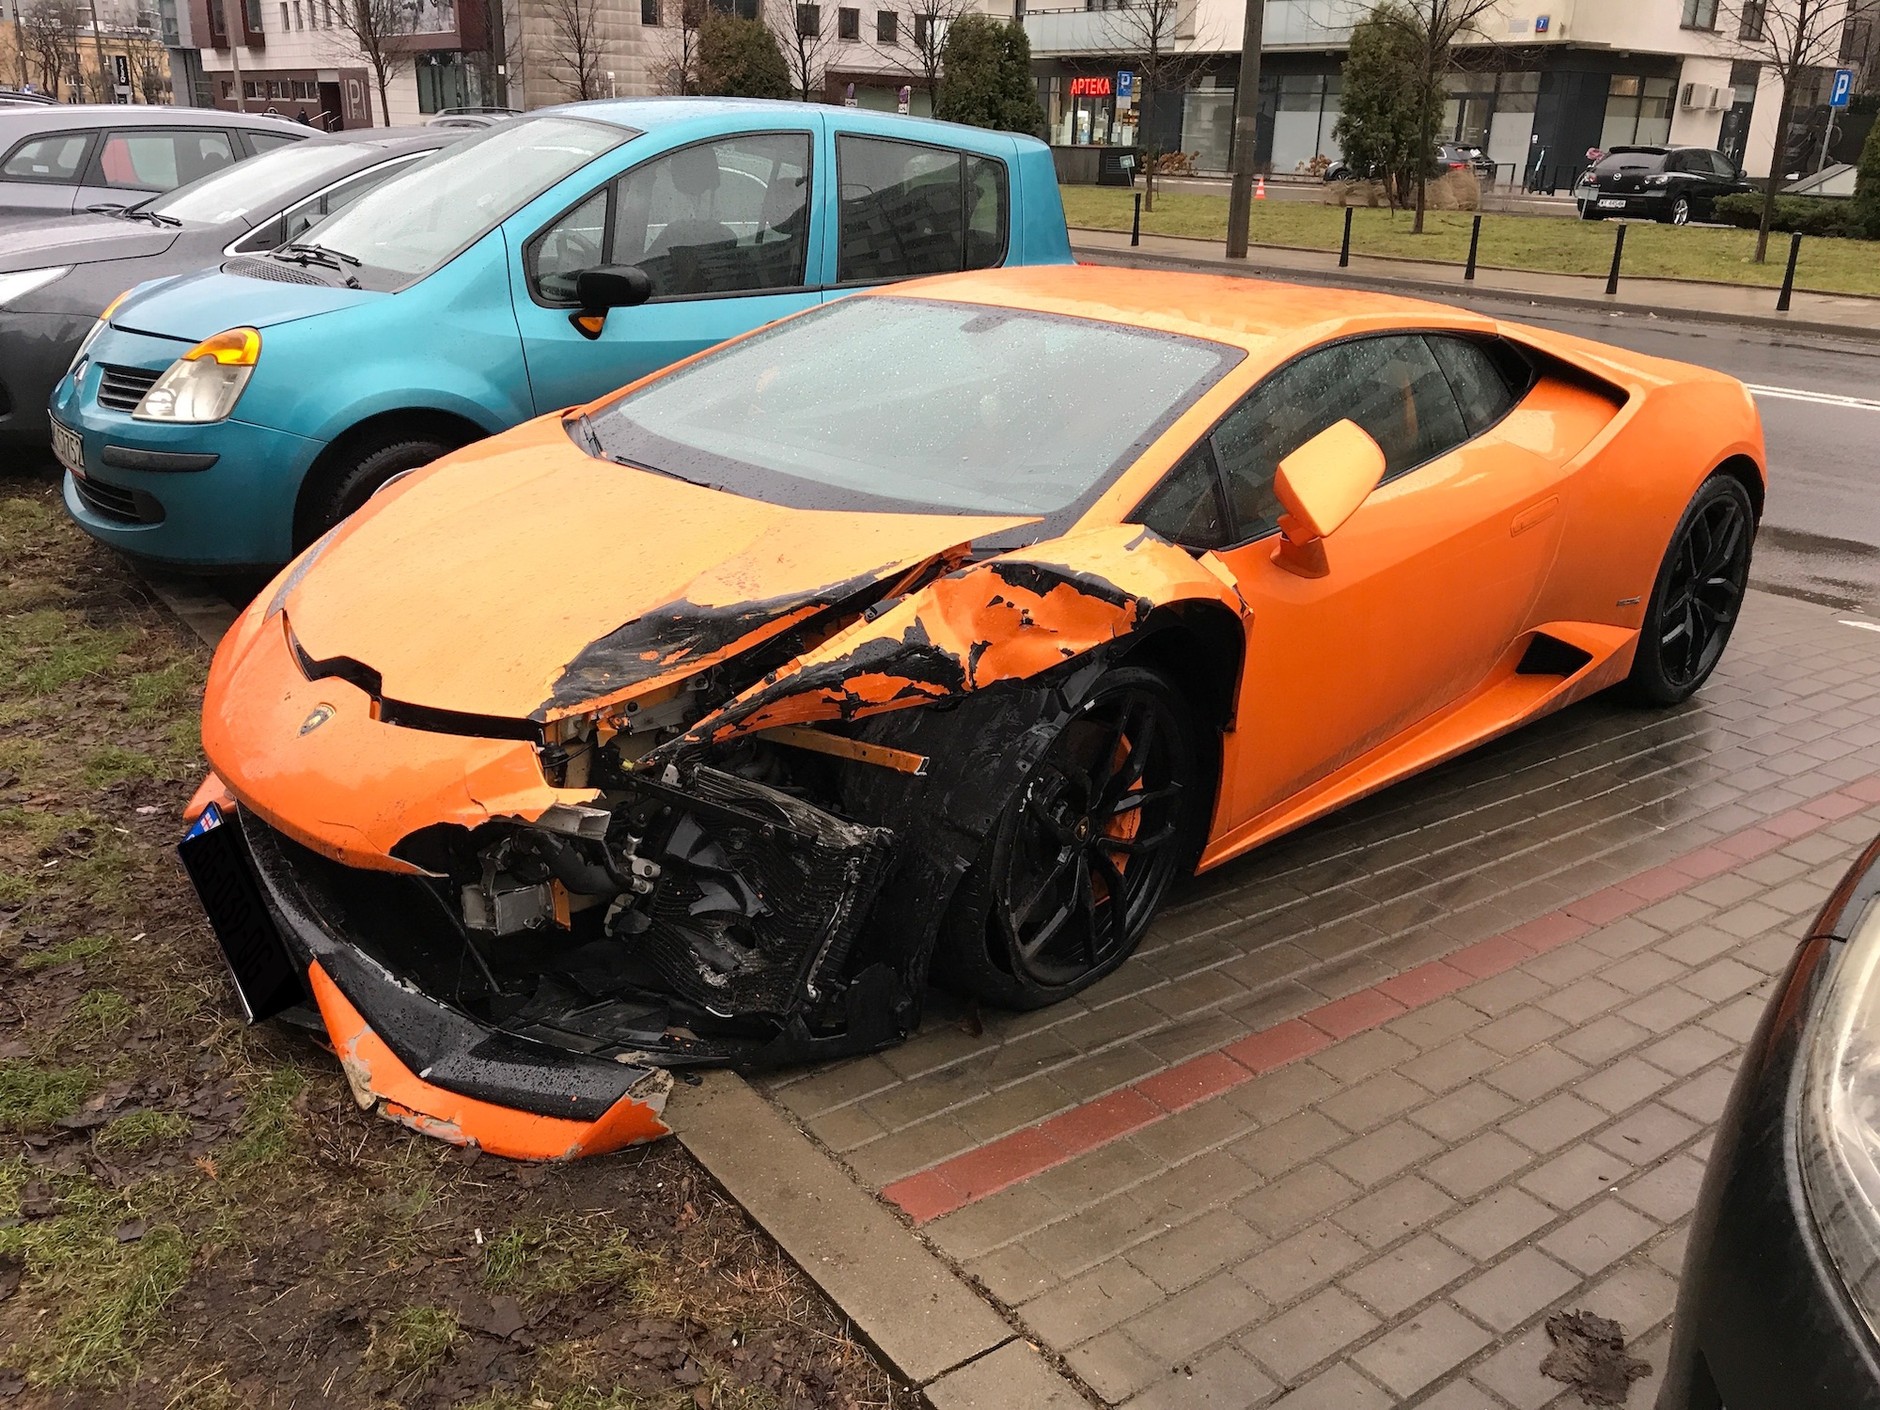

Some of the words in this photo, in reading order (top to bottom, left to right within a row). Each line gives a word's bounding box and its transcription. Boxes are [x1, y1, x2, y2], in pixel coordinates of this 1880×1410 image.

[1070, 78, 1111, 95] APTEKA
[1121, 74, 1130, 89] P
[1834, 74, 1849, 102] P
